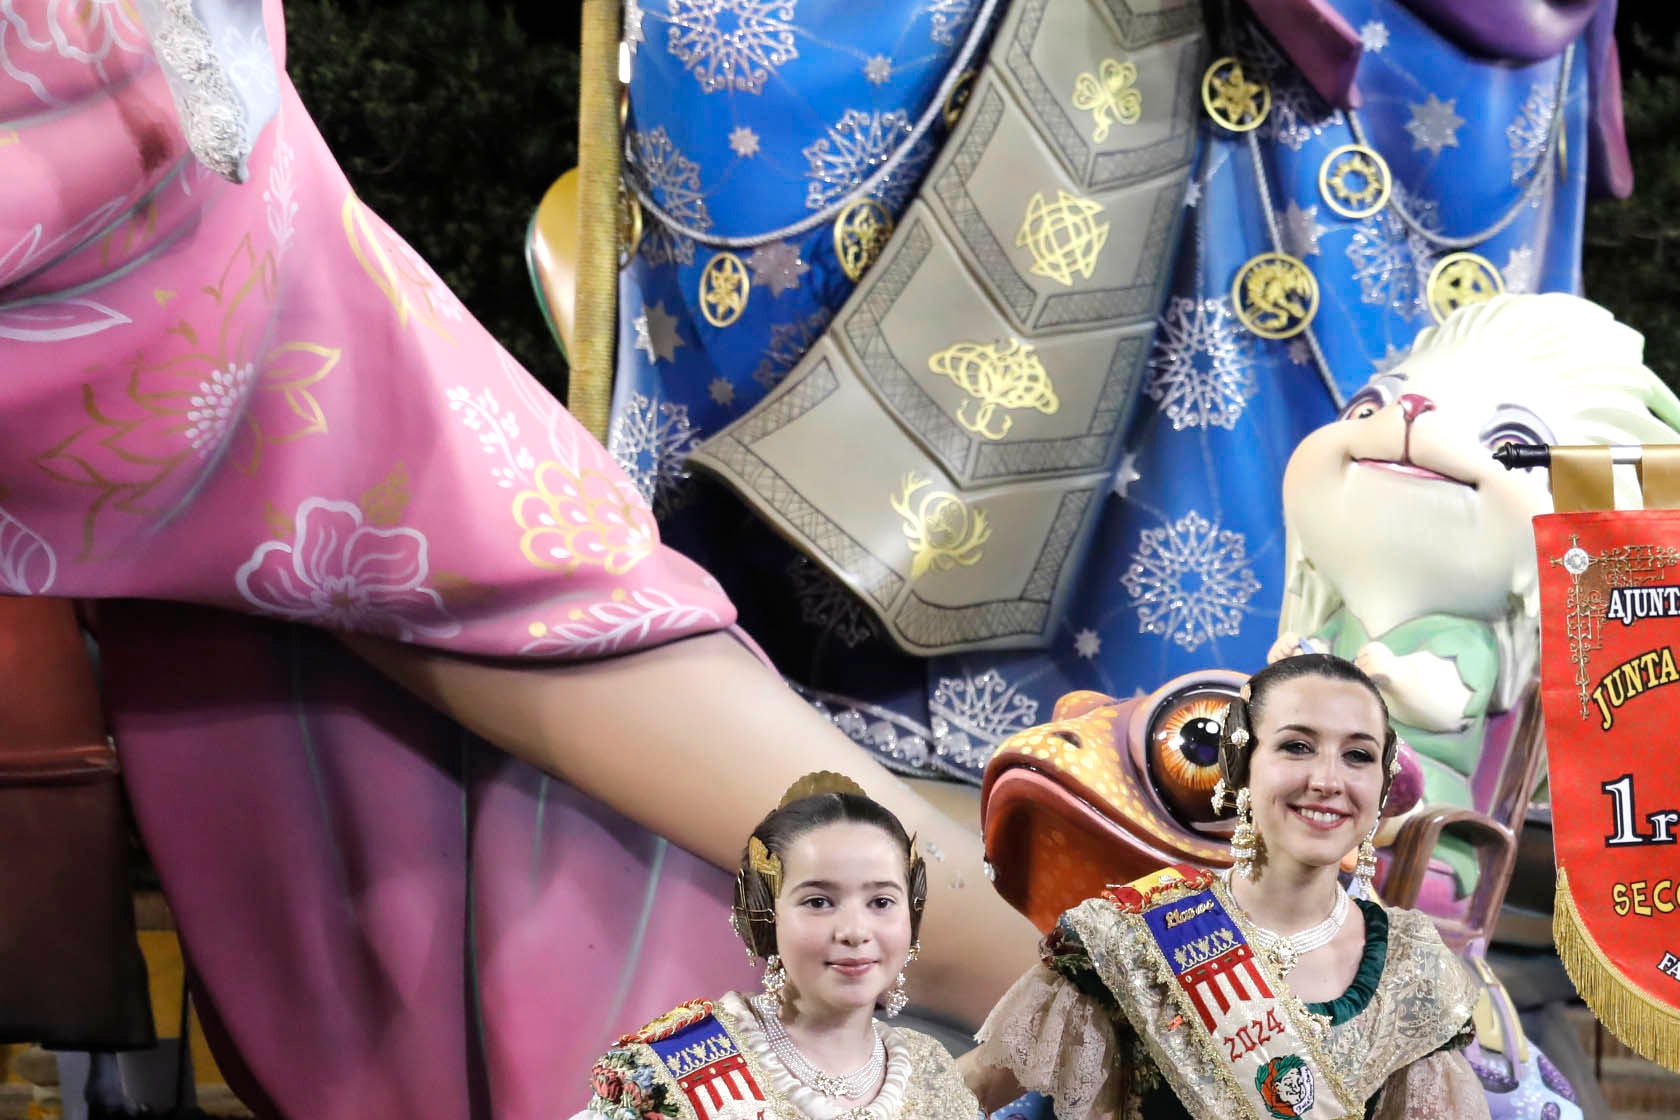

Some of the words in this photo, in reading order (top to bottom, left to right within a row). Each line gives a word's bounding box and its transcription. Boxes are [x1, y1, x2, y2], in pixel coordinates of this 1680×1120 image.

[1592, 653, 1678, 731] JUNTA
[1603, 776, 1680, 848] 1r
[1223, 1007, 1286, 1063] 2024
